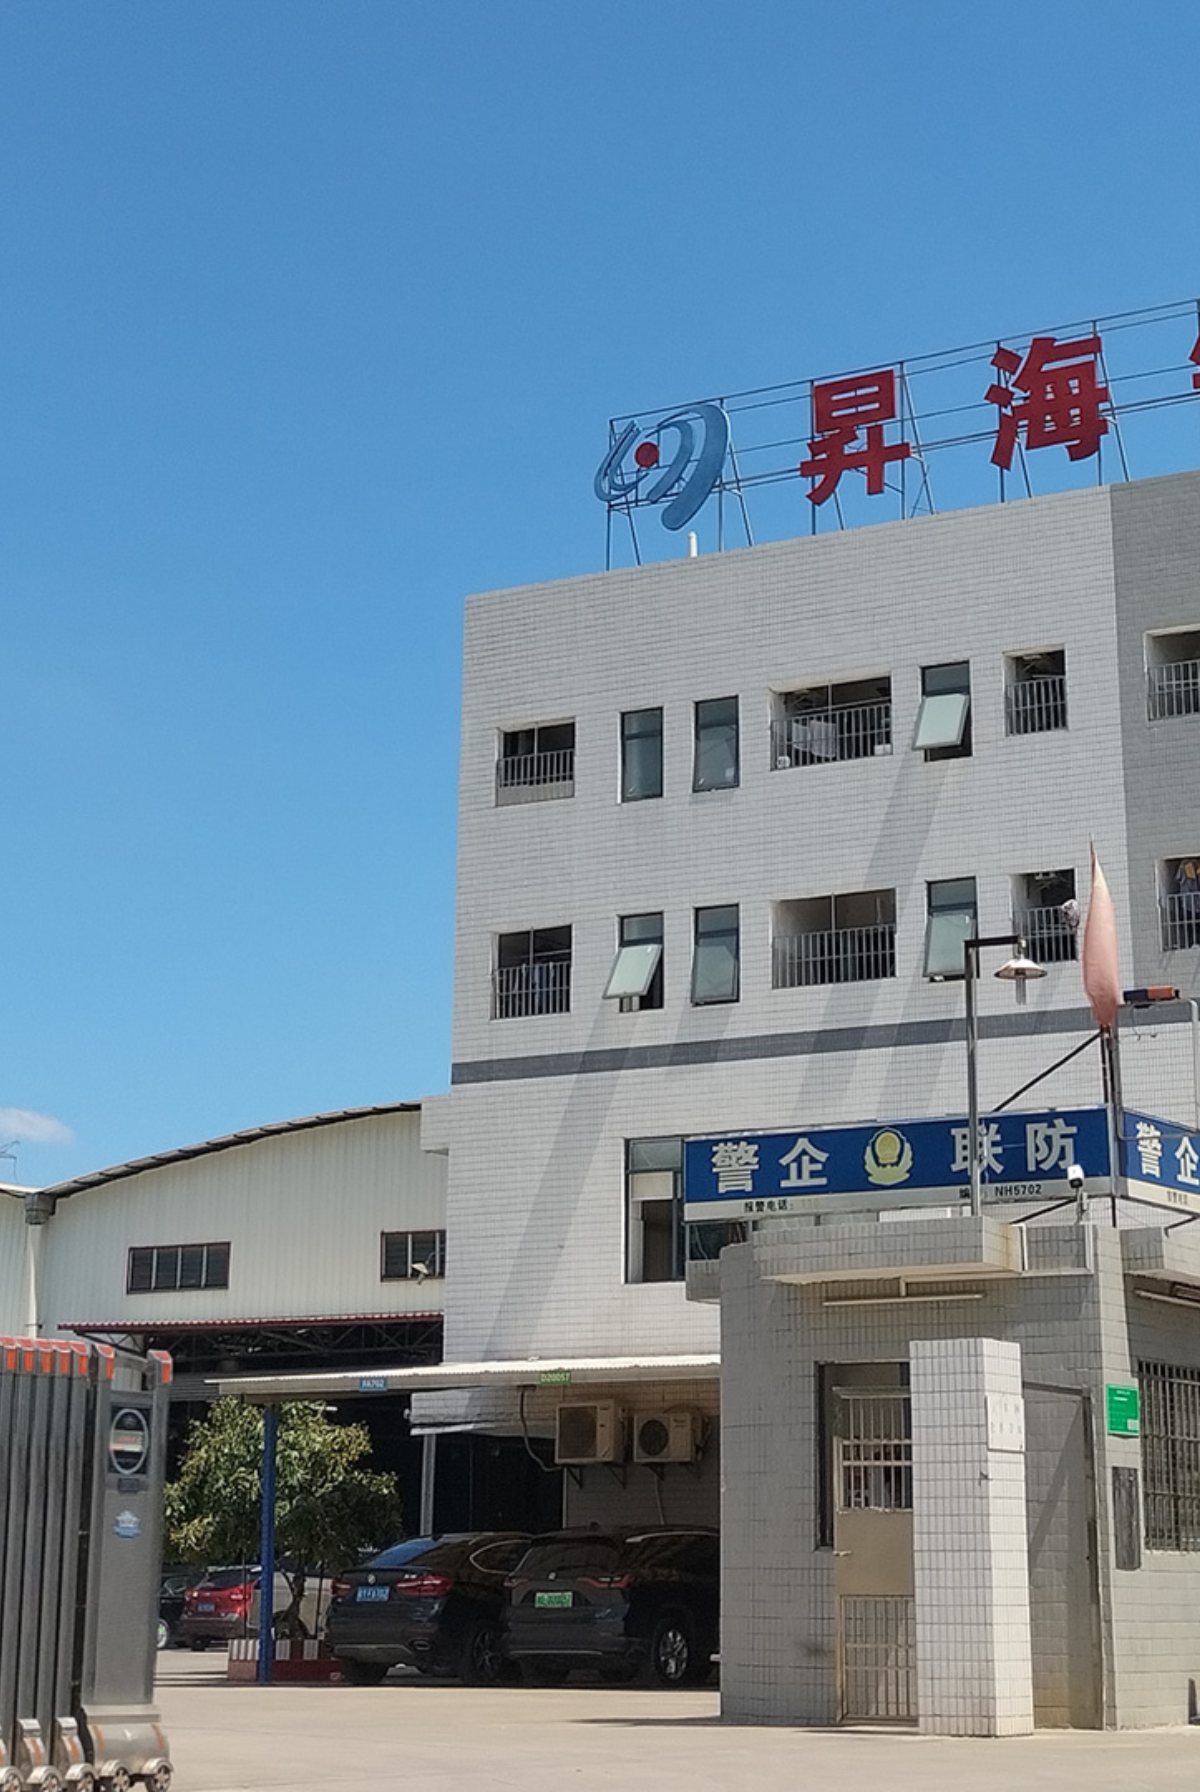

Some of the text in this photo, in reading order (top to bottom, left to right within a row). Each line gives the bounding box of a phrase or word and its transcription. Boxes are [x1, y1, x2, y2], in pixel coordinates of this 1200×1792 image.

[711, 1118, 1079, 1193] 警企 联防
[1135, 1121, 1200, 1187] 警企
[995, 1184, 1042, 1197] NH5702
